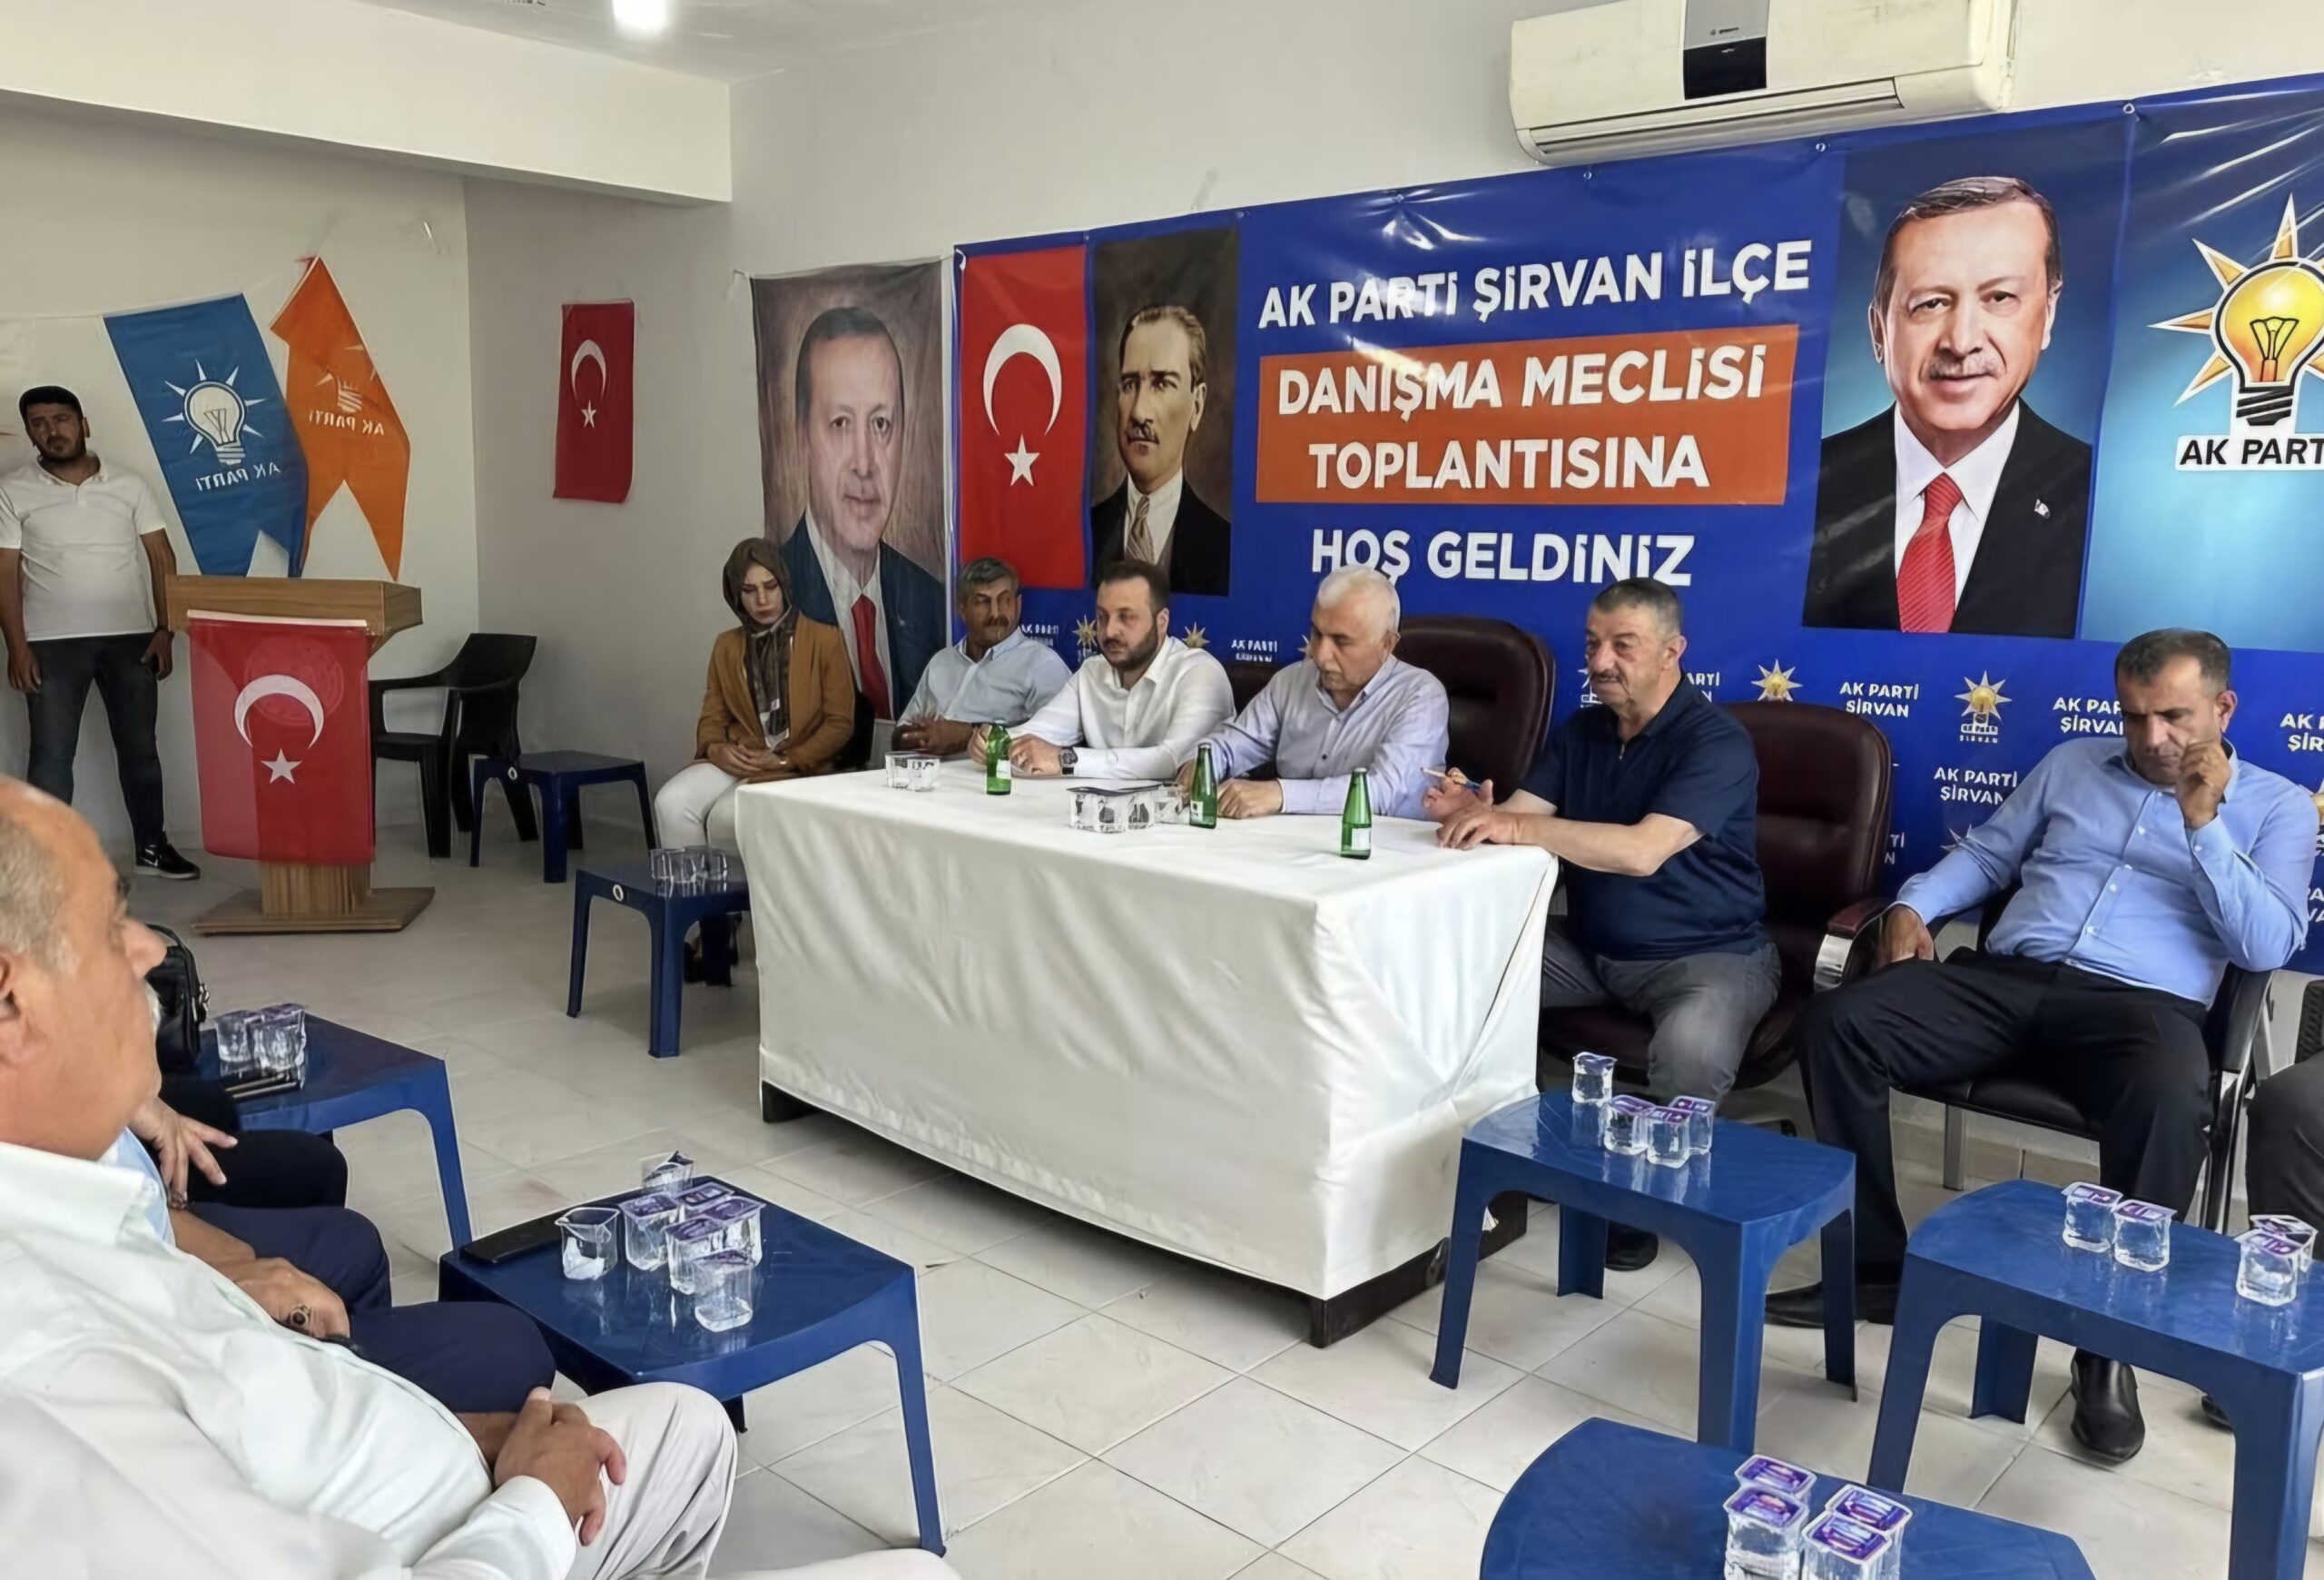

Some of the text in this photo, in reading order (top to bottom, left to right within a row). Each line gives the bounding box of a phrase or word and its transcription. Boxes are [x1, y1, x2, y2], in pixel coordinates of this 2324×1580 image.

[1258, 240, 1812, 329] AK PARTİ ŞİRVAN İLÇE
[1278, 344, 1767, 422] DANIŞMA MECLİSİ
[1308, 435, 1710, 489] TOPLANTISINA
[2180, 439, 2324, 465] AK PART
[1312, 528, 1696, 587] HOŞ GELDİNİZ
[1839, 681, 1865, 696] AK
[2053, 696, 2122, 715] AK PAR
[2280, 712, 2314, 730] AK
[2288, 732, 2324, 752] ŞİR
[1934, 766, 1959, 782] AK
